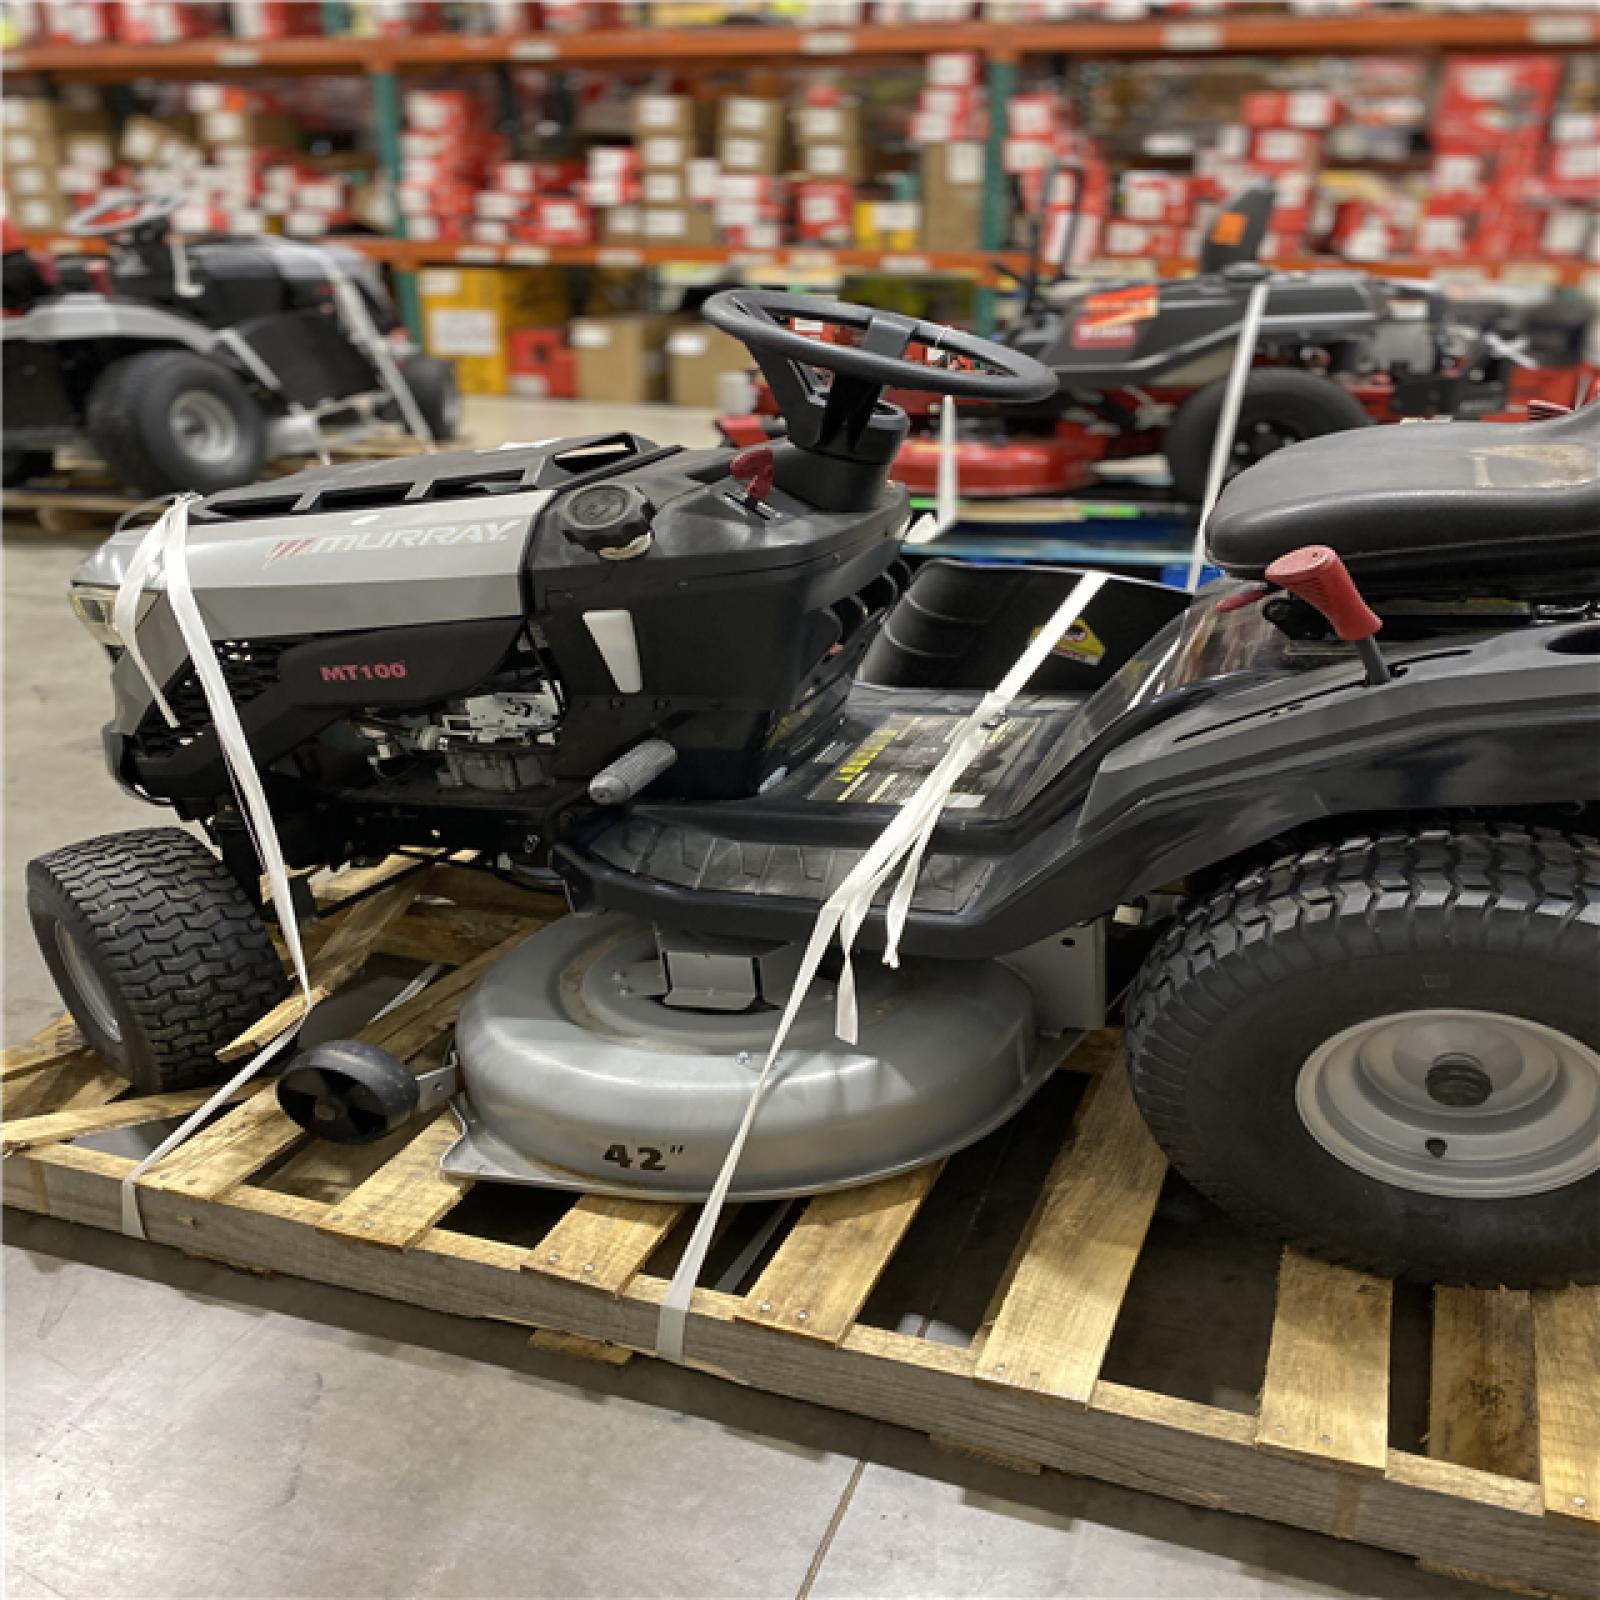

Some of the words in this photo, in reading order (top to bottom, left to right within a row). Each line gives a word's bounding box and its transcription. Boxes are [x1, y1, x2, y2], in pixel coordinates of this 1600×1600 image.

[311, 520, 520, 552] MURRAY
[320, 662, 407, 681] MT100
[603, 1144, 685, 1170] 42"
